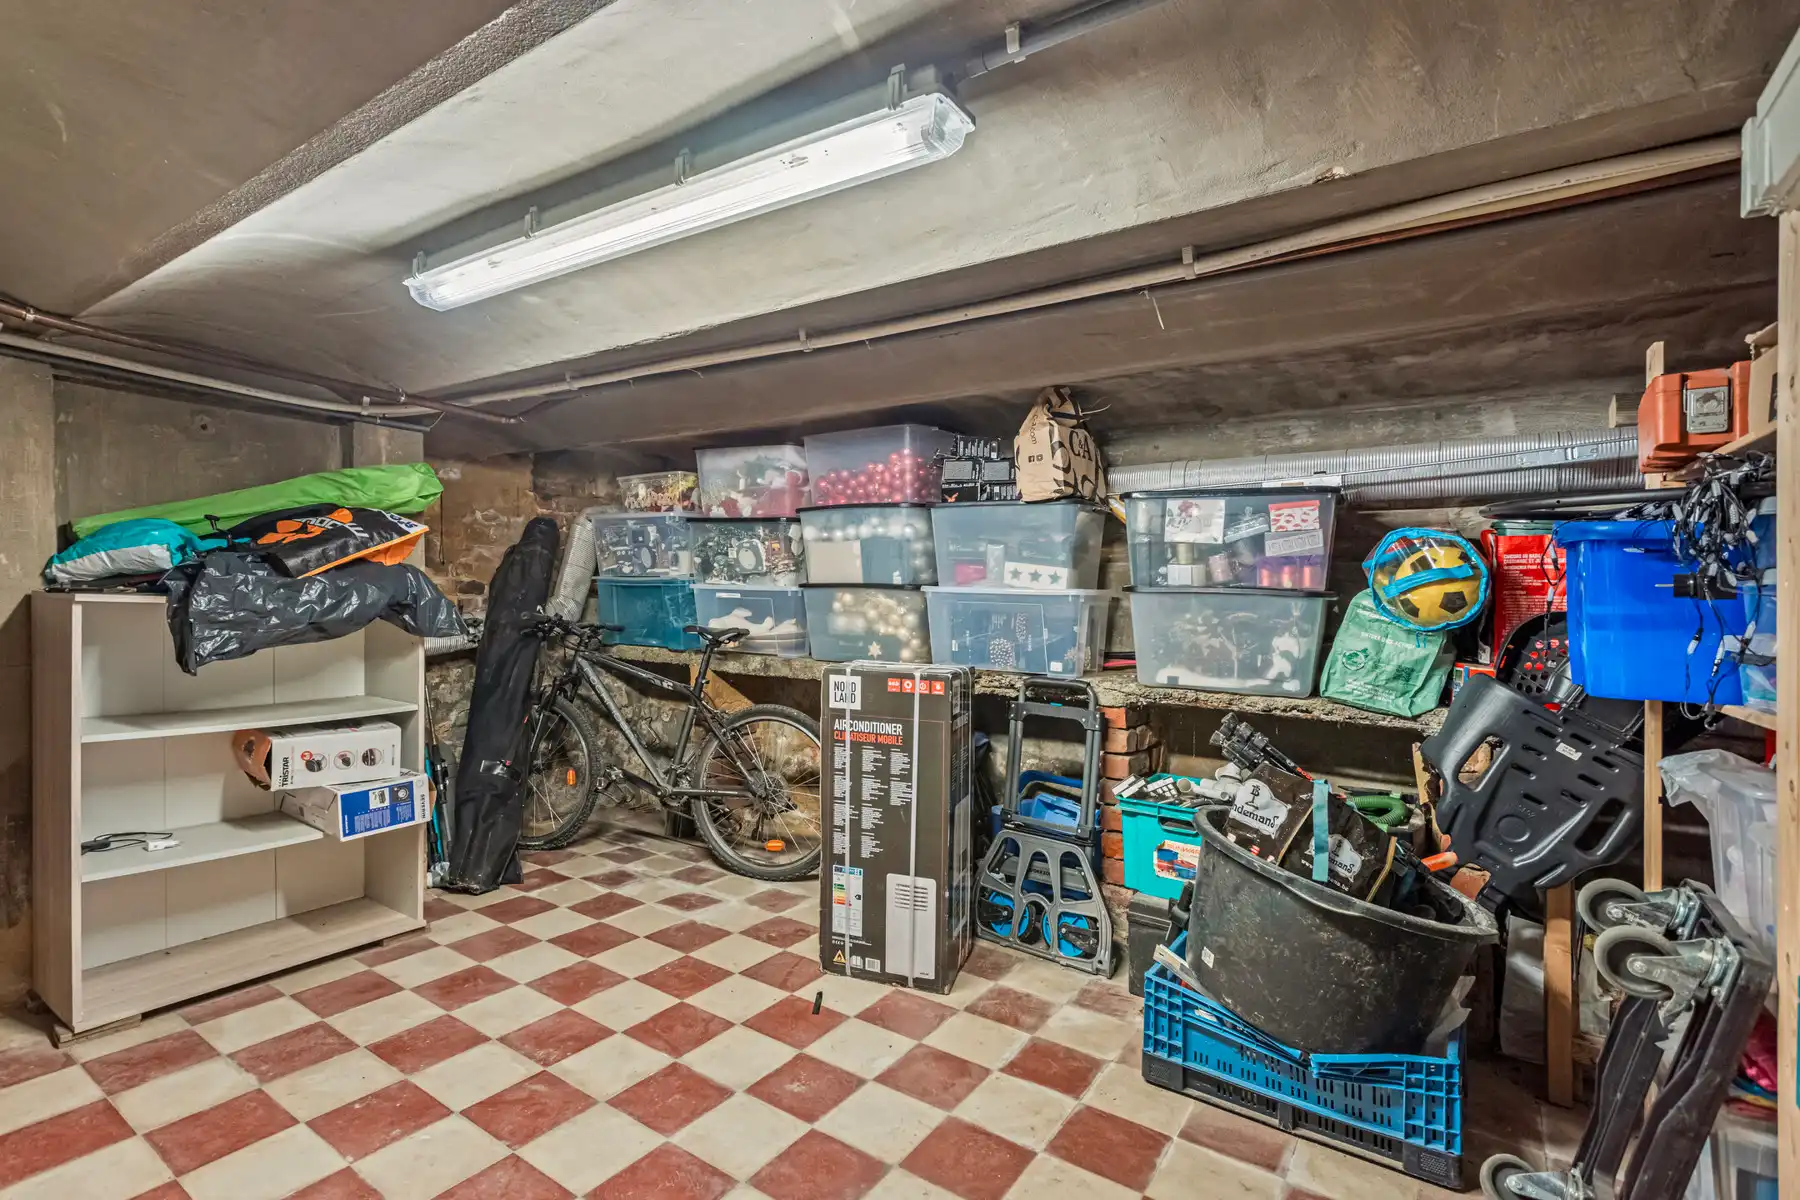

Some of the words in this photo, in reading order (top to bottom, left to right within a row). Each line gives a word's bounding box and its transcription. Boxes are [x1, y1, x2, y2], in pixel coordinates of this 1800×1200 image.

[1069, 429, 1093, 461] C&A
[834, 681, 857, 692] NOD
[834, 718, 903, 735] AIRCONDITIONER
[834, 730, 876, 743] CLIATISEUR
[877, 734, 903, 746] MOBILE
[1232, 803, 1279, 829] ndemanS
